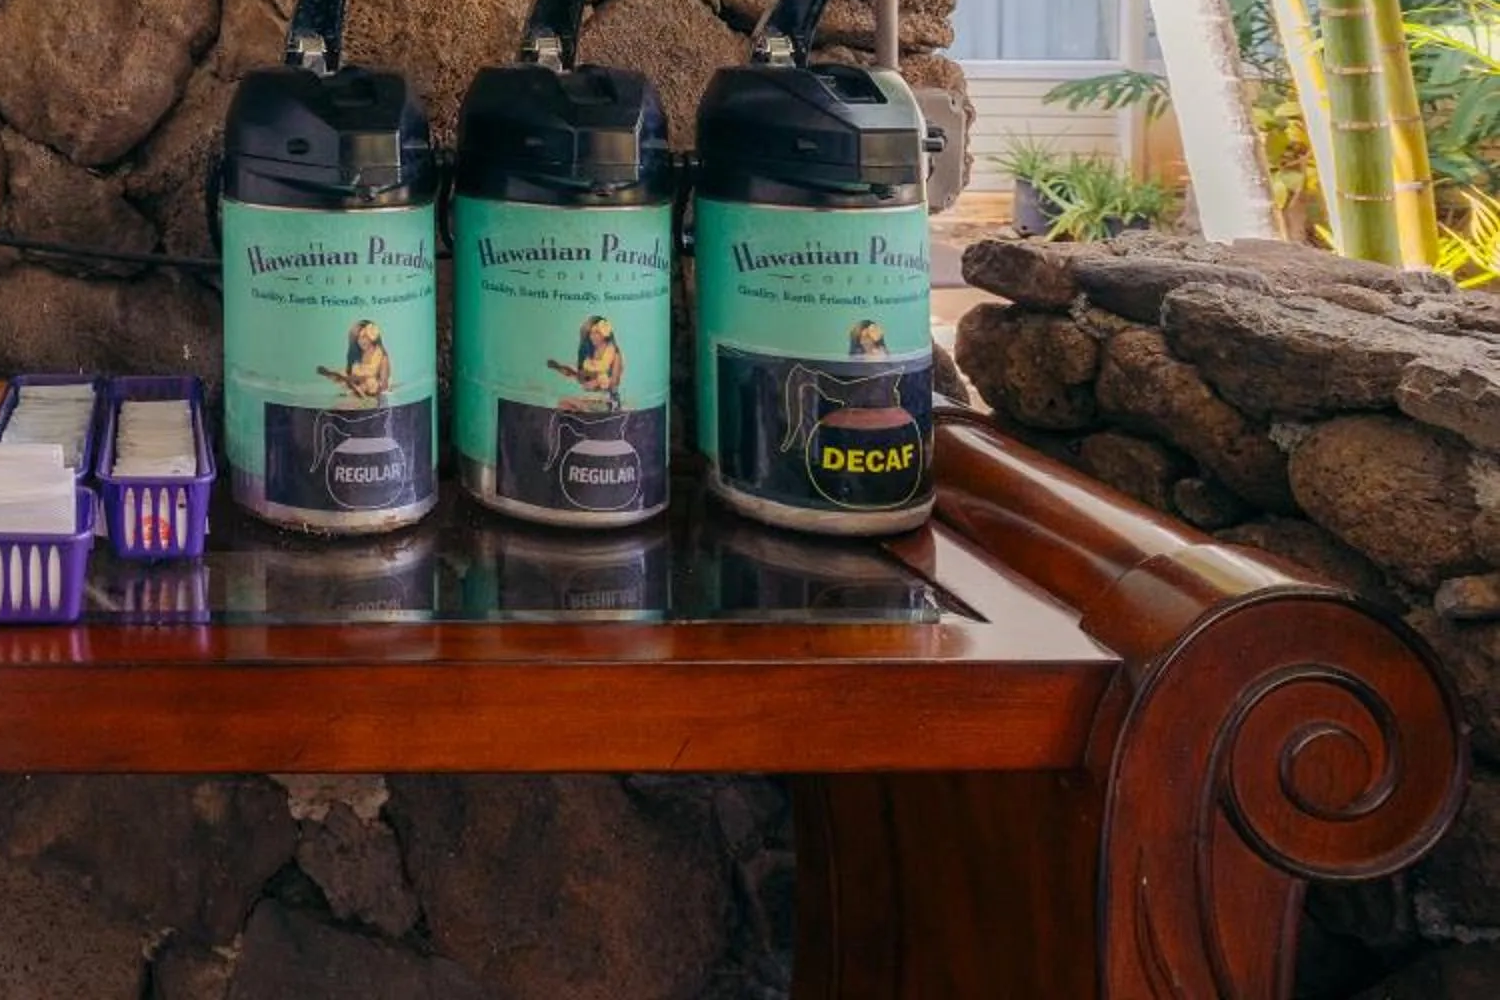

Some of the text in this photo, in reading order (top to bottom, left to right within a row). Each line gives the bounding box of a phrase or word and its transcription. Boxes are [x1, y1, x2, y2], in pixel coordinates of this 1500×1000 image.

[248, 241, 359, 275] Hawaiian
[478, 236, 591, 268] Hawaiian
[732, 240, 859, 273] Hawaiian
[335, 462, 401, 483] REGULAR
[823, 444, 914, 473] DECAF
[569, 466, 635, 485] REGULAR
